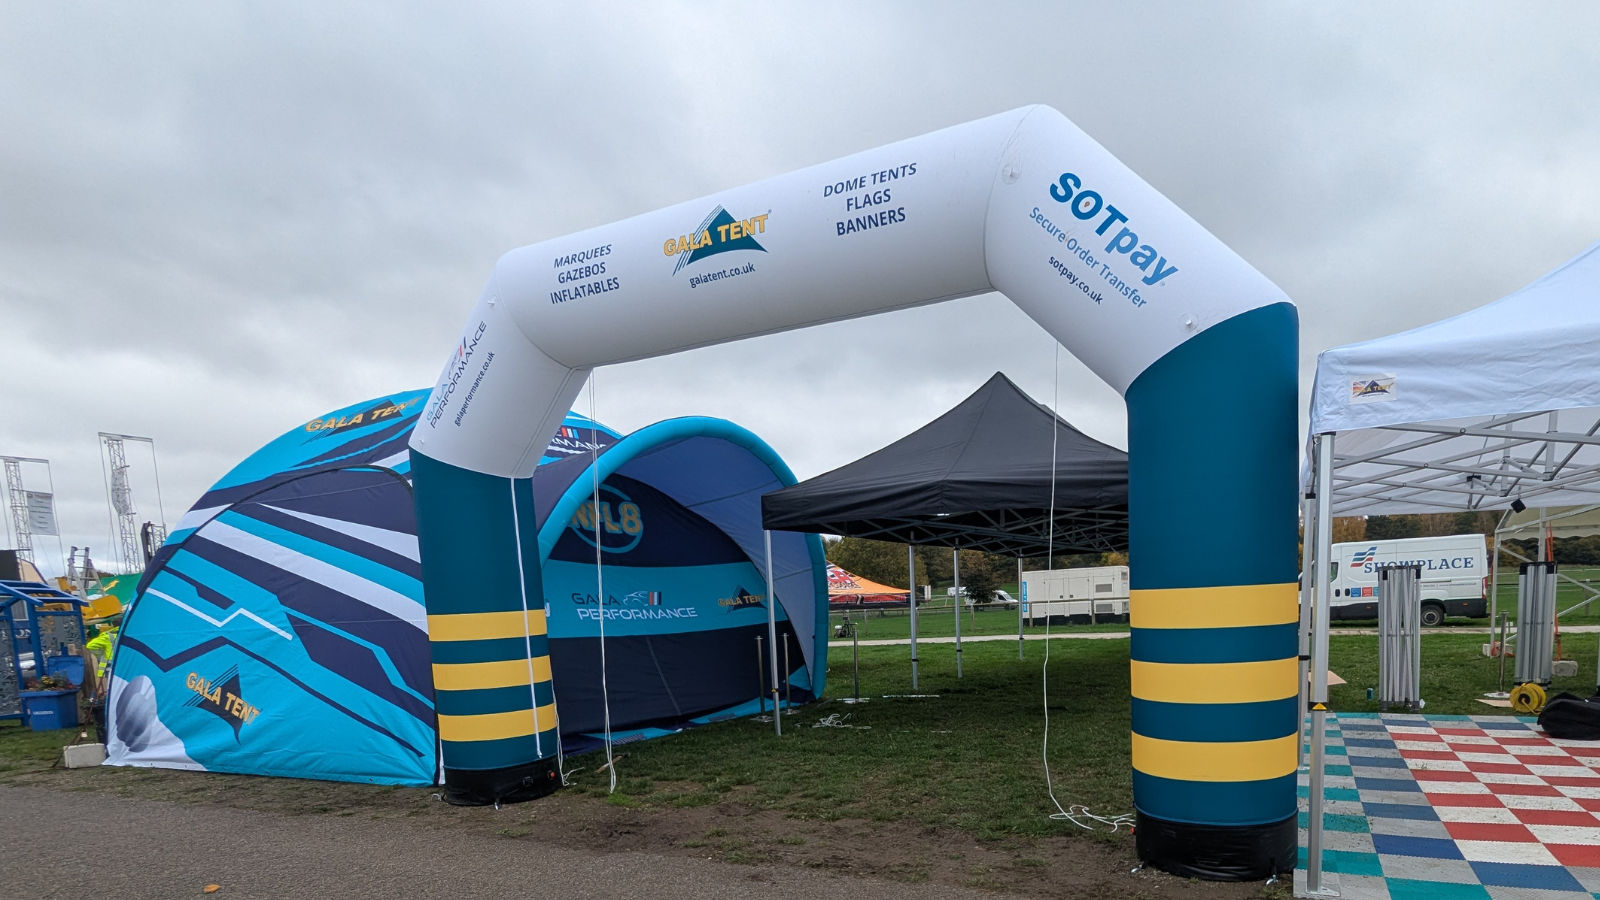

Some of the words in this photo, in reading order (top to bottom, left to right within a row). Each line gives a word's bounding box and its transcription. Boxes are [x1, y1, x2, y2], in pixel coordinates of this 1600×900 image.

[823, 175, 867, 198] DOME
[870, 162, 918, 184] TENTS
[845, 188, 892, 212] FLAGS
[663, 230, 712, 257] GALA
[717, 213, 770, 244] TENT
[836, 206, 906, 237] BANNERS
[1049, 172, 1179, 286] SOTpay
[553, 243, 613, 269] MARQUEES
[1029, 206, 1067, 243] Secure
[1066, 238, 1100, 269] Order
[1099, 263, 1148, 309] Transfer
[558, 261, 607, 284] GAZEBOS
[689, 261, 756, 289] galatent.co.uk
[1048, 256, 1104, 305] sotpay.co.uk
[550, 276, 620, 305] INFLATABLES
[430, 320, 487, 429] PERFORMANCE
[454, 351, 496, 427] galaperformance.co.uk
[304, 413, 364, 433] GALA
[571, 592, 621, 606] GALA
[576, 607, 698, 620] PERFORMANCE
[185, 671, 222, 706] GALA
[224, 691, 261, 726] TENT
